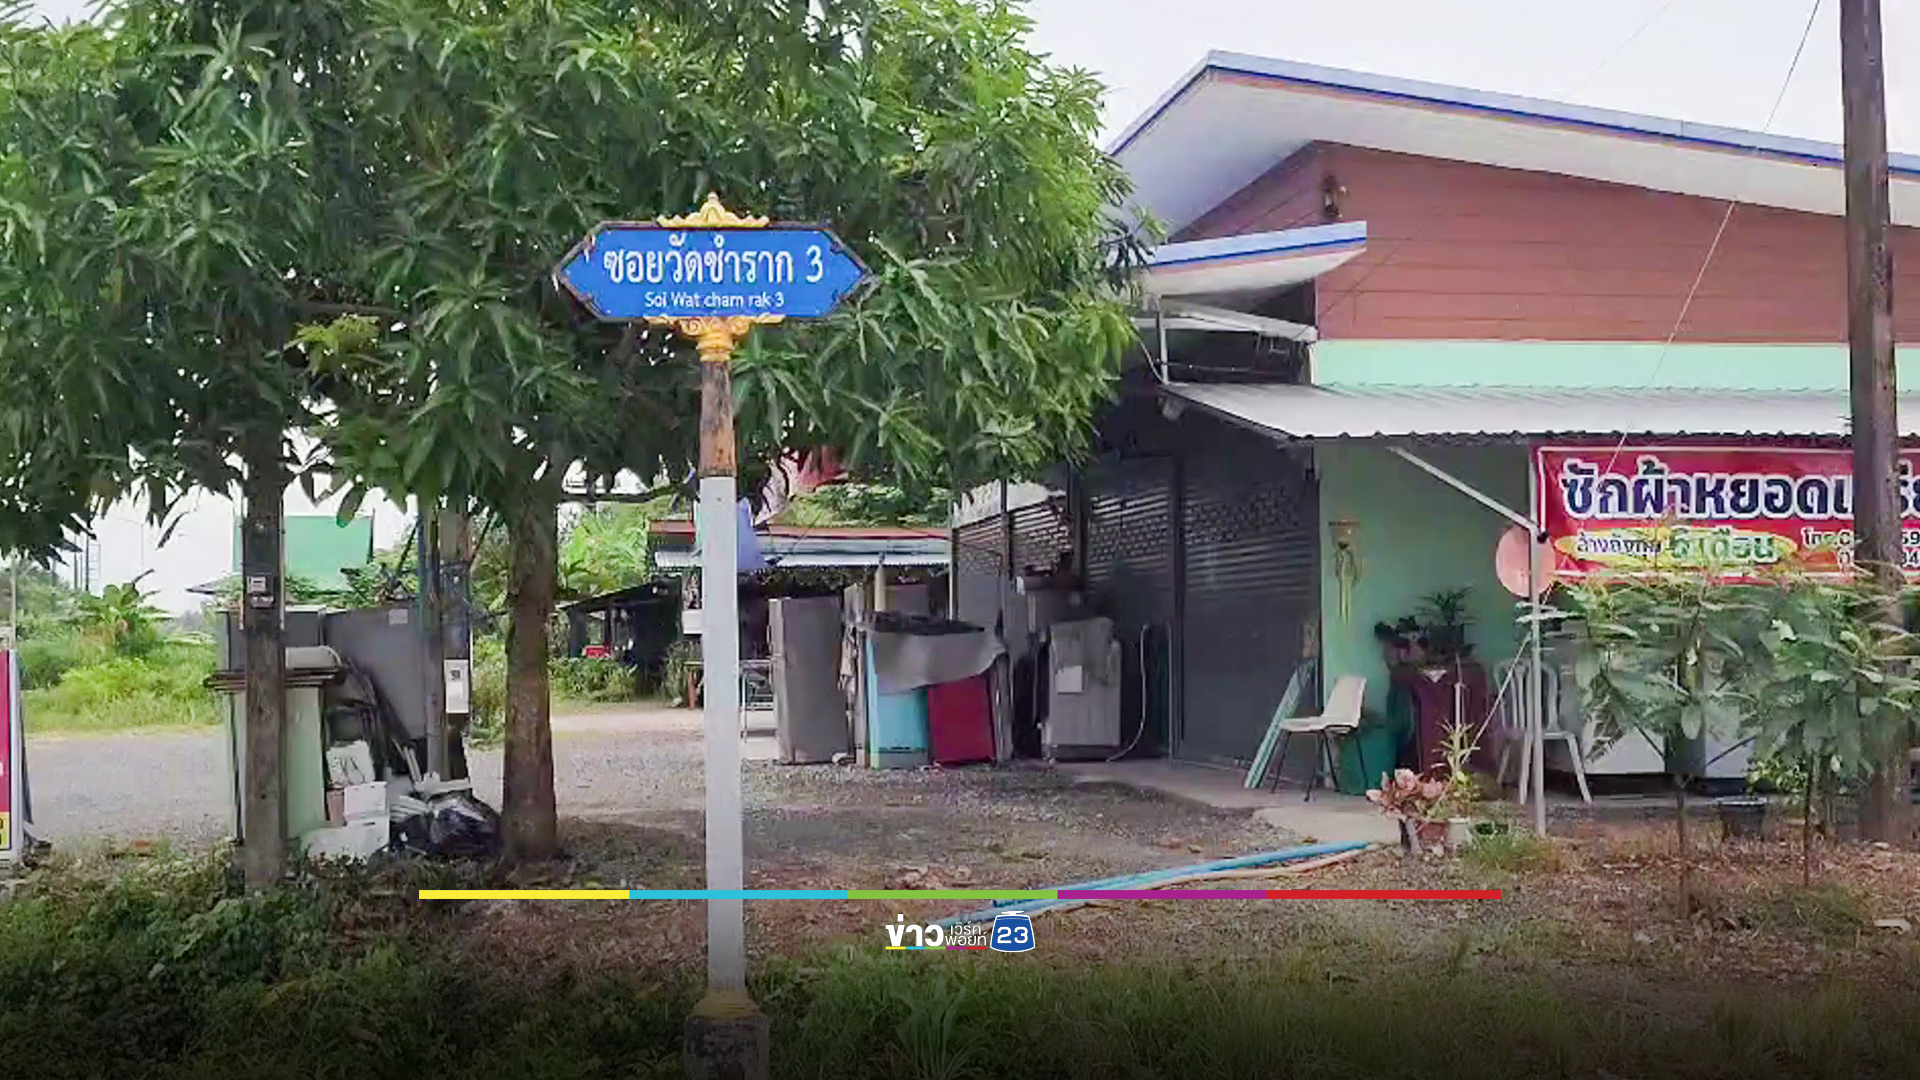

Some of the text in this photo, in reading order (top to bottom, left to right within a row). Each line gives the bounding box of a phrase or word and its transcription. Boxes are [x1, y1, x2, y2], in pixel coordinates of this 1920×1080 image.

[603, 233, 823, 283] ซอยวัดชำราก 3
[645, 292, 669, 308] Soi
[671, 292, 700, 308] Wat
[749, 292, 772, 308] rak
[775, 292, 785, 308] 3
